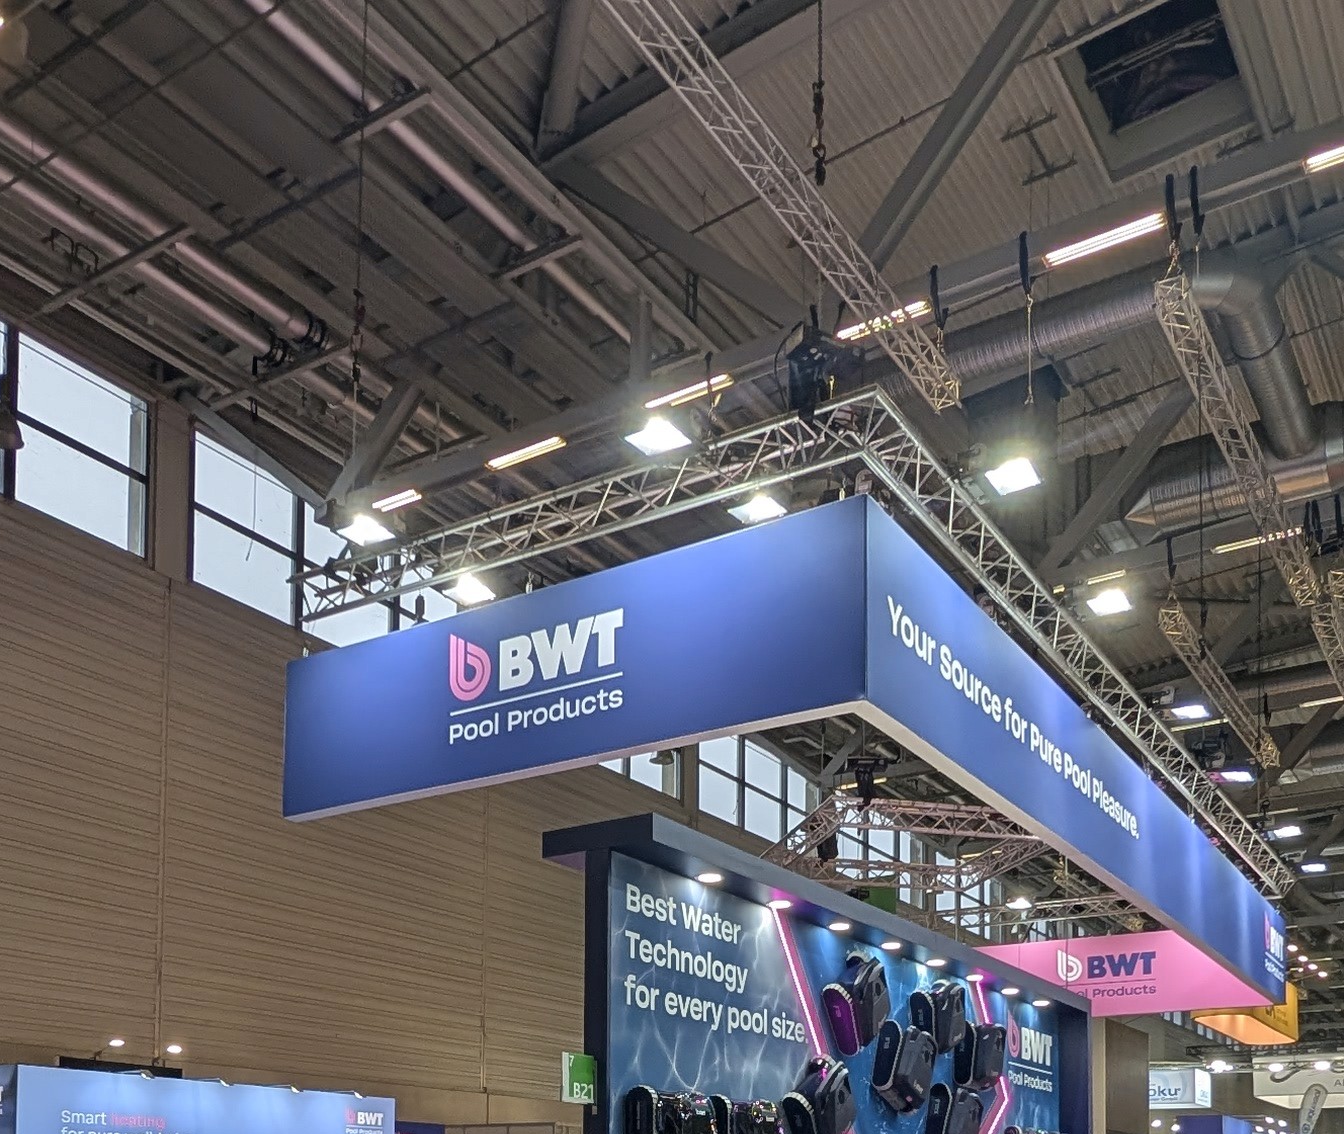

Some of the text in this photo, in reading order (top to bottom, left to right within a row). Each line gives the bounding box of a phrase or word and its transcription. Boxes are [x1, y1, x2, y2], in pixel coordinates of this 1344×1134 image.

[499, 608, 624, 692] BWT
[449, 688, 624, 745] Pool Products
[887, 595, 1140, 840] Your Source for Pure Pool Pleasure.
[626, 883, 742, 945] Best Water
[625, 930, 749, 994] Technology
[1270, 926, 1284, 962] BWT
[1087, 951, 1156, 979] BWT
[624, 974, 809, 1044] for every pool size.
[1093, 984, 1156, 998] Products
[569, 1055, 574, 1067] 7
[1021, 1026, 1053, 1066] BWT
[573, 1082, 594, 1099] B21
[1023, 1073, 1053, 1093] Products
[61, 1110, 107, 1126] Smart
[357, 1111, 384, 1126] BWT
